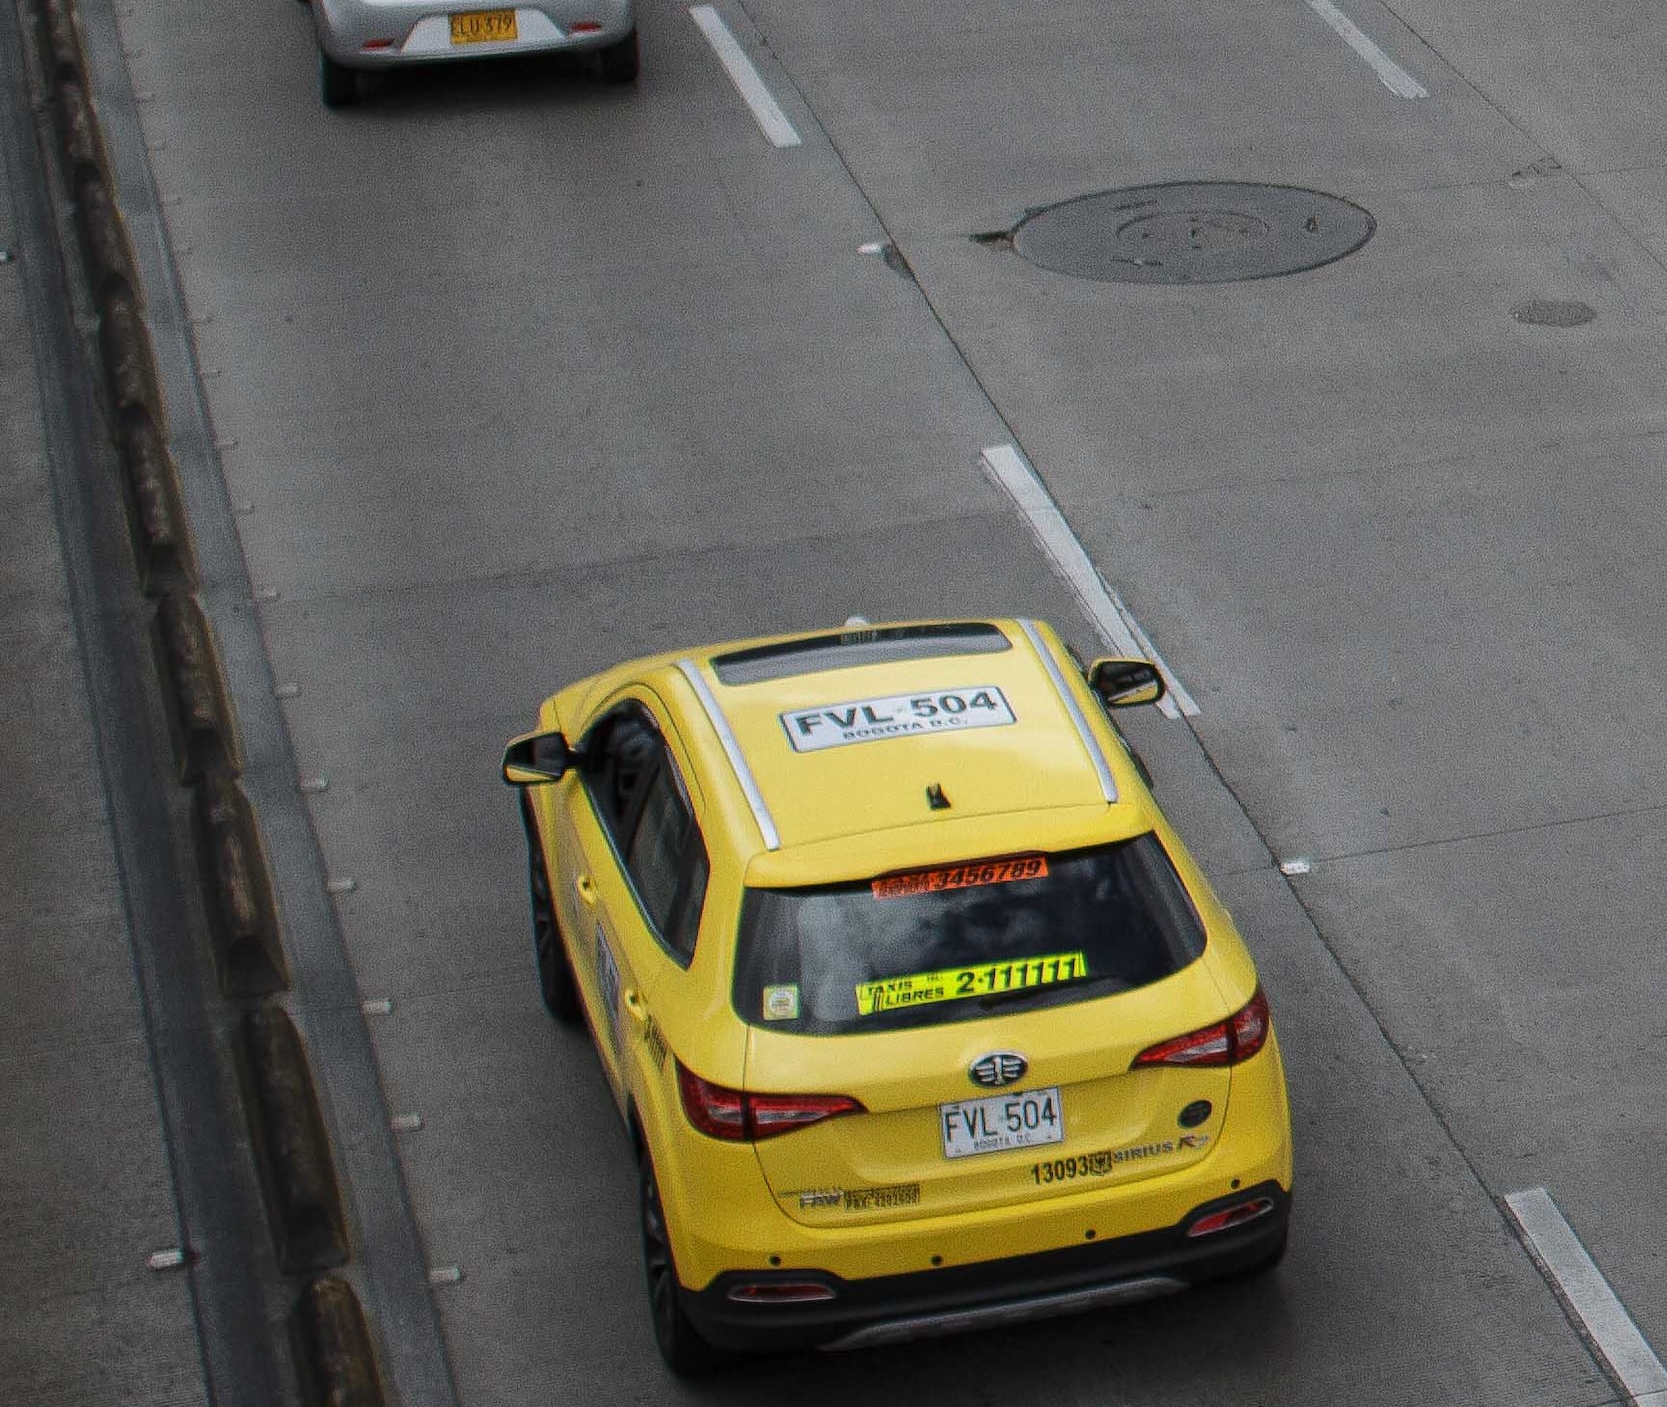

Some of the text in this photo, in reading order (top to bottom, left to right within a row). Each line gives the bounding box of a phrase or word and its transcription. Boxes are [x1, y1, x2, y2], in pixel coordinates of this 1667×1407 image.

[796, 691, 999, 737] FVL 504
[842, 721, 924, 740] BOGOTA
[933, 858, 1044, 891] 3456789
[867, 980, 914, 996] TAXIS
[886, 985, 945, 1005] LIBRES
[945, 1096, 1057, 1143] FVL 504
[1030, 1157, 1089, 1185] 13093
[1113, 1140, 1174, 1164] SIRIUS
